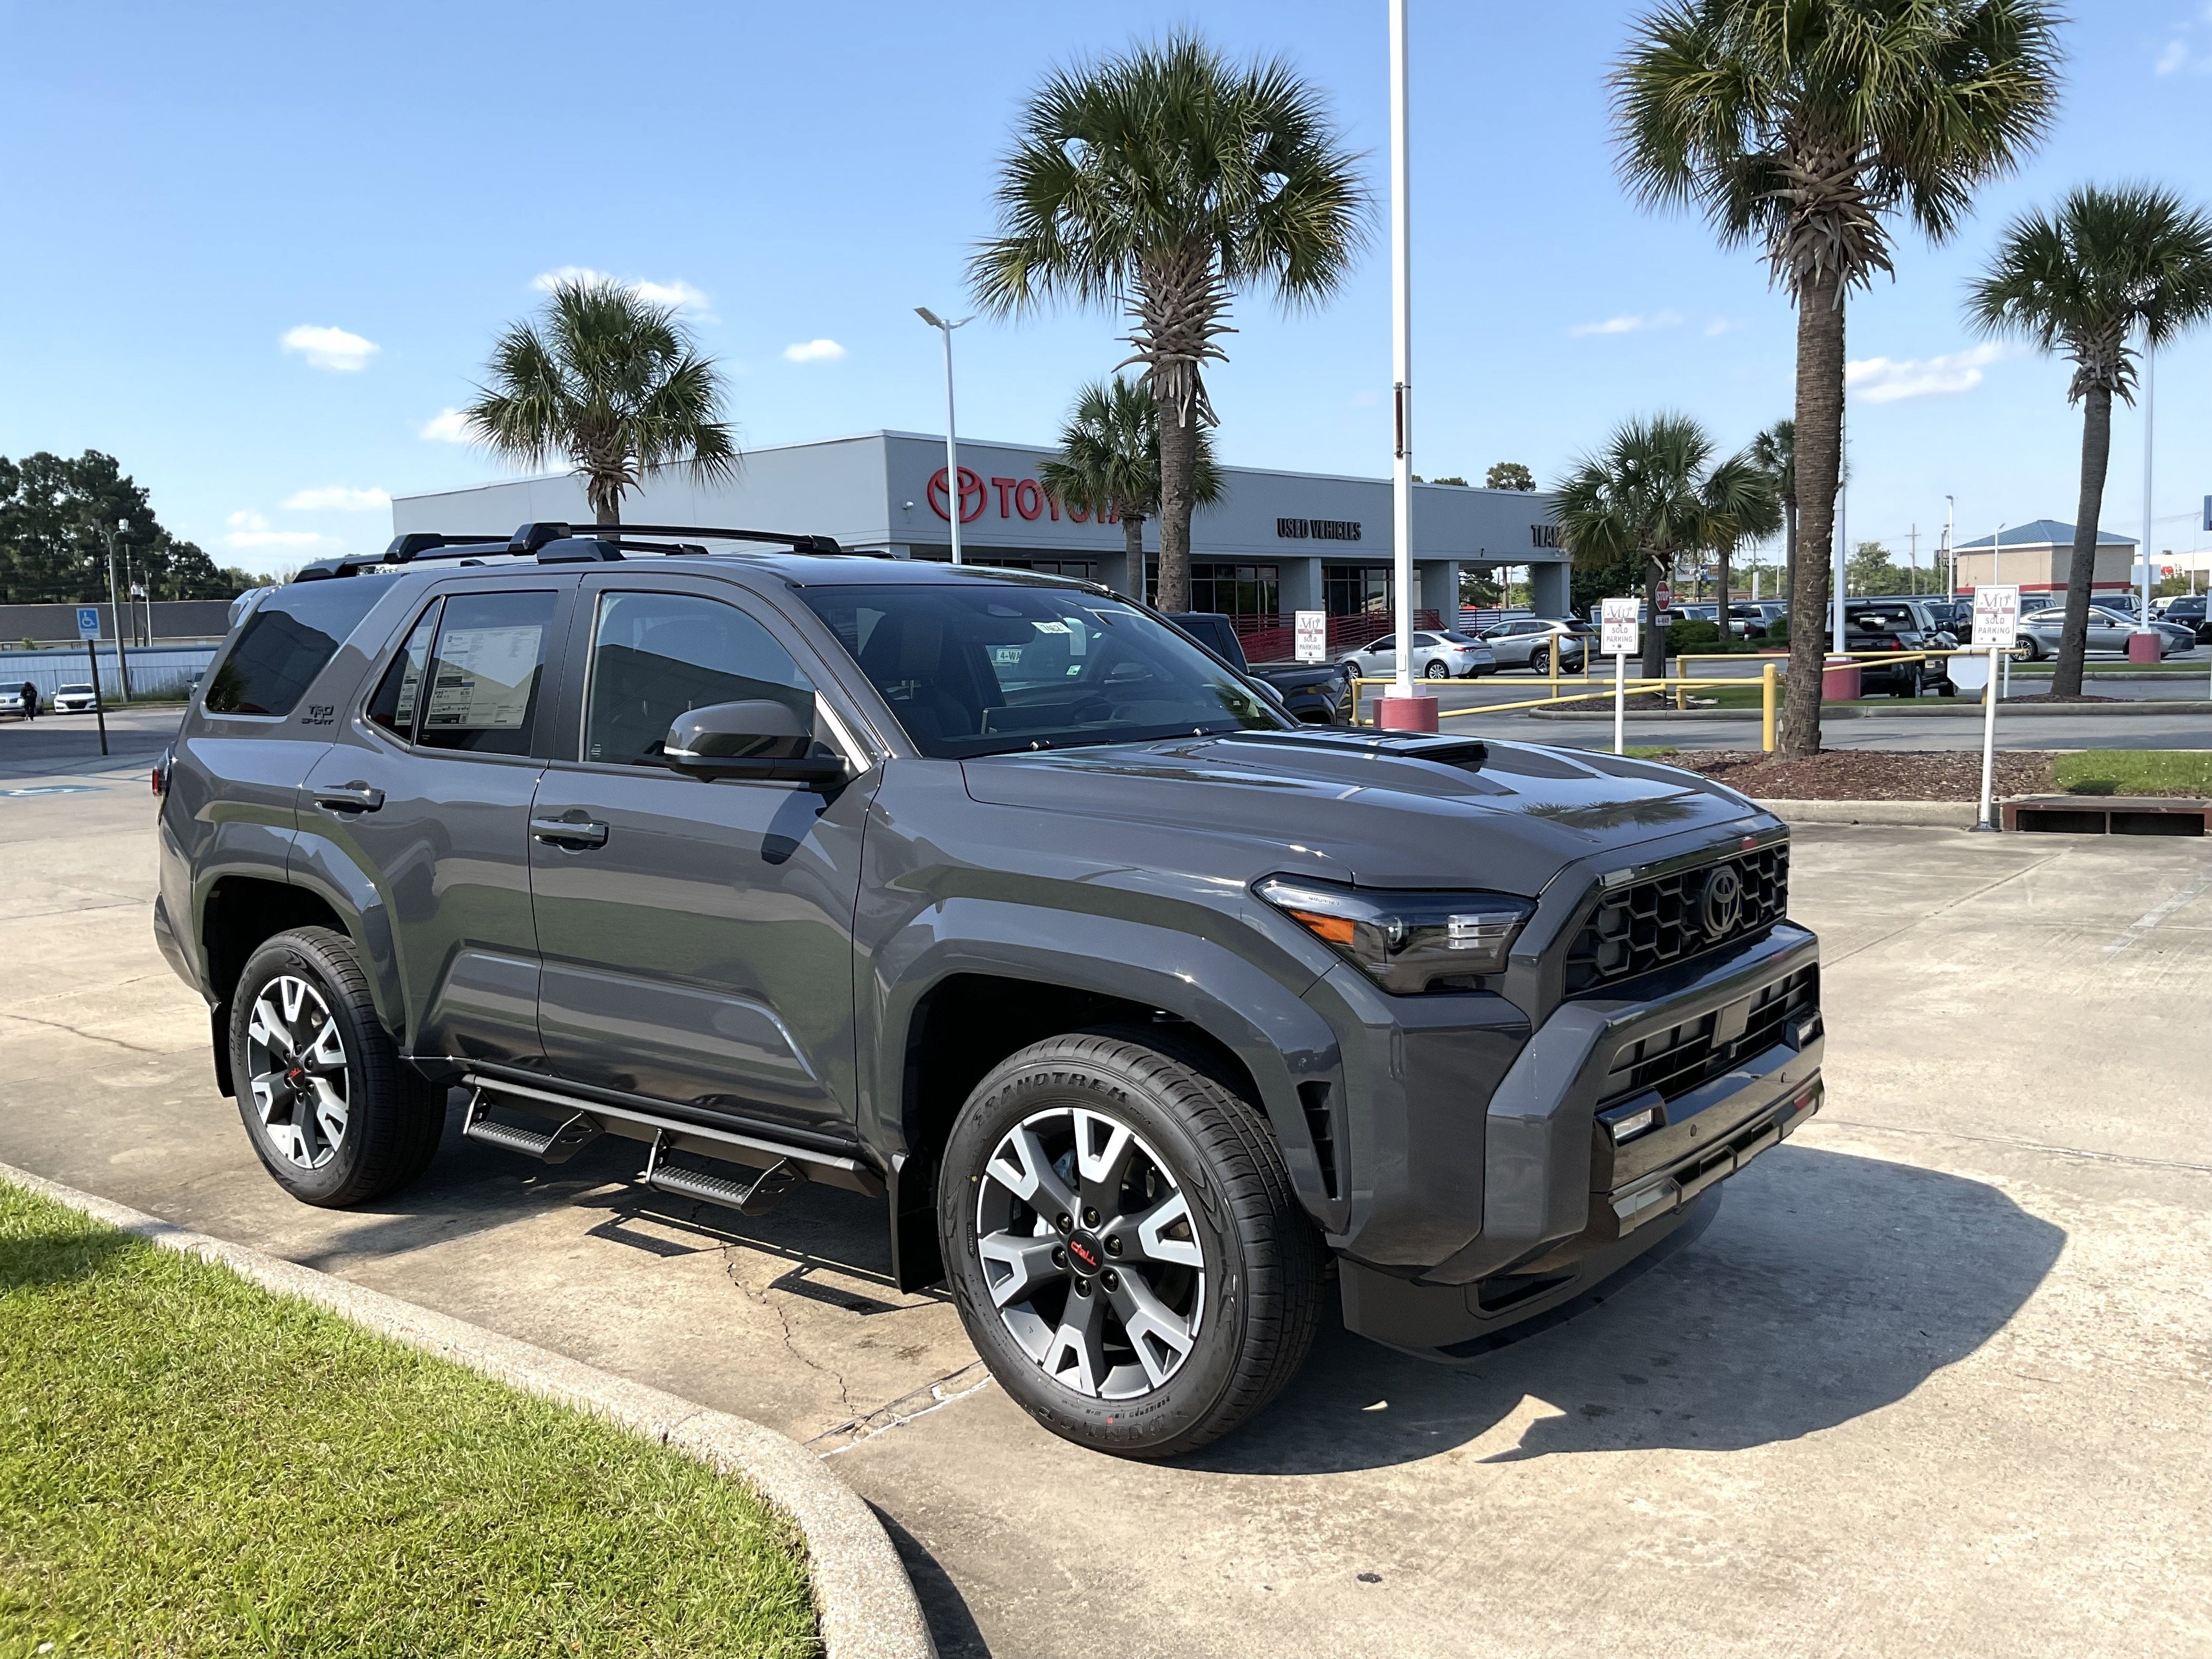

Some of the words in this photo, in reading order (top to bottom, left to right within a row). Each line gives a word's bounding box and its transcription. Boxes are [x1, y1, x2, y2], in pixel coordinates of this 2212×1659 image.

[1277, 518, 1308, 538] USED
[1310, 520, 1362, 540] VEHICLES
[1657, 591, 1668, 601] STOP
[970, 1071, 1132, 1133] GRANDTREK
[1070, 1240, 1097, 1267] TRD
